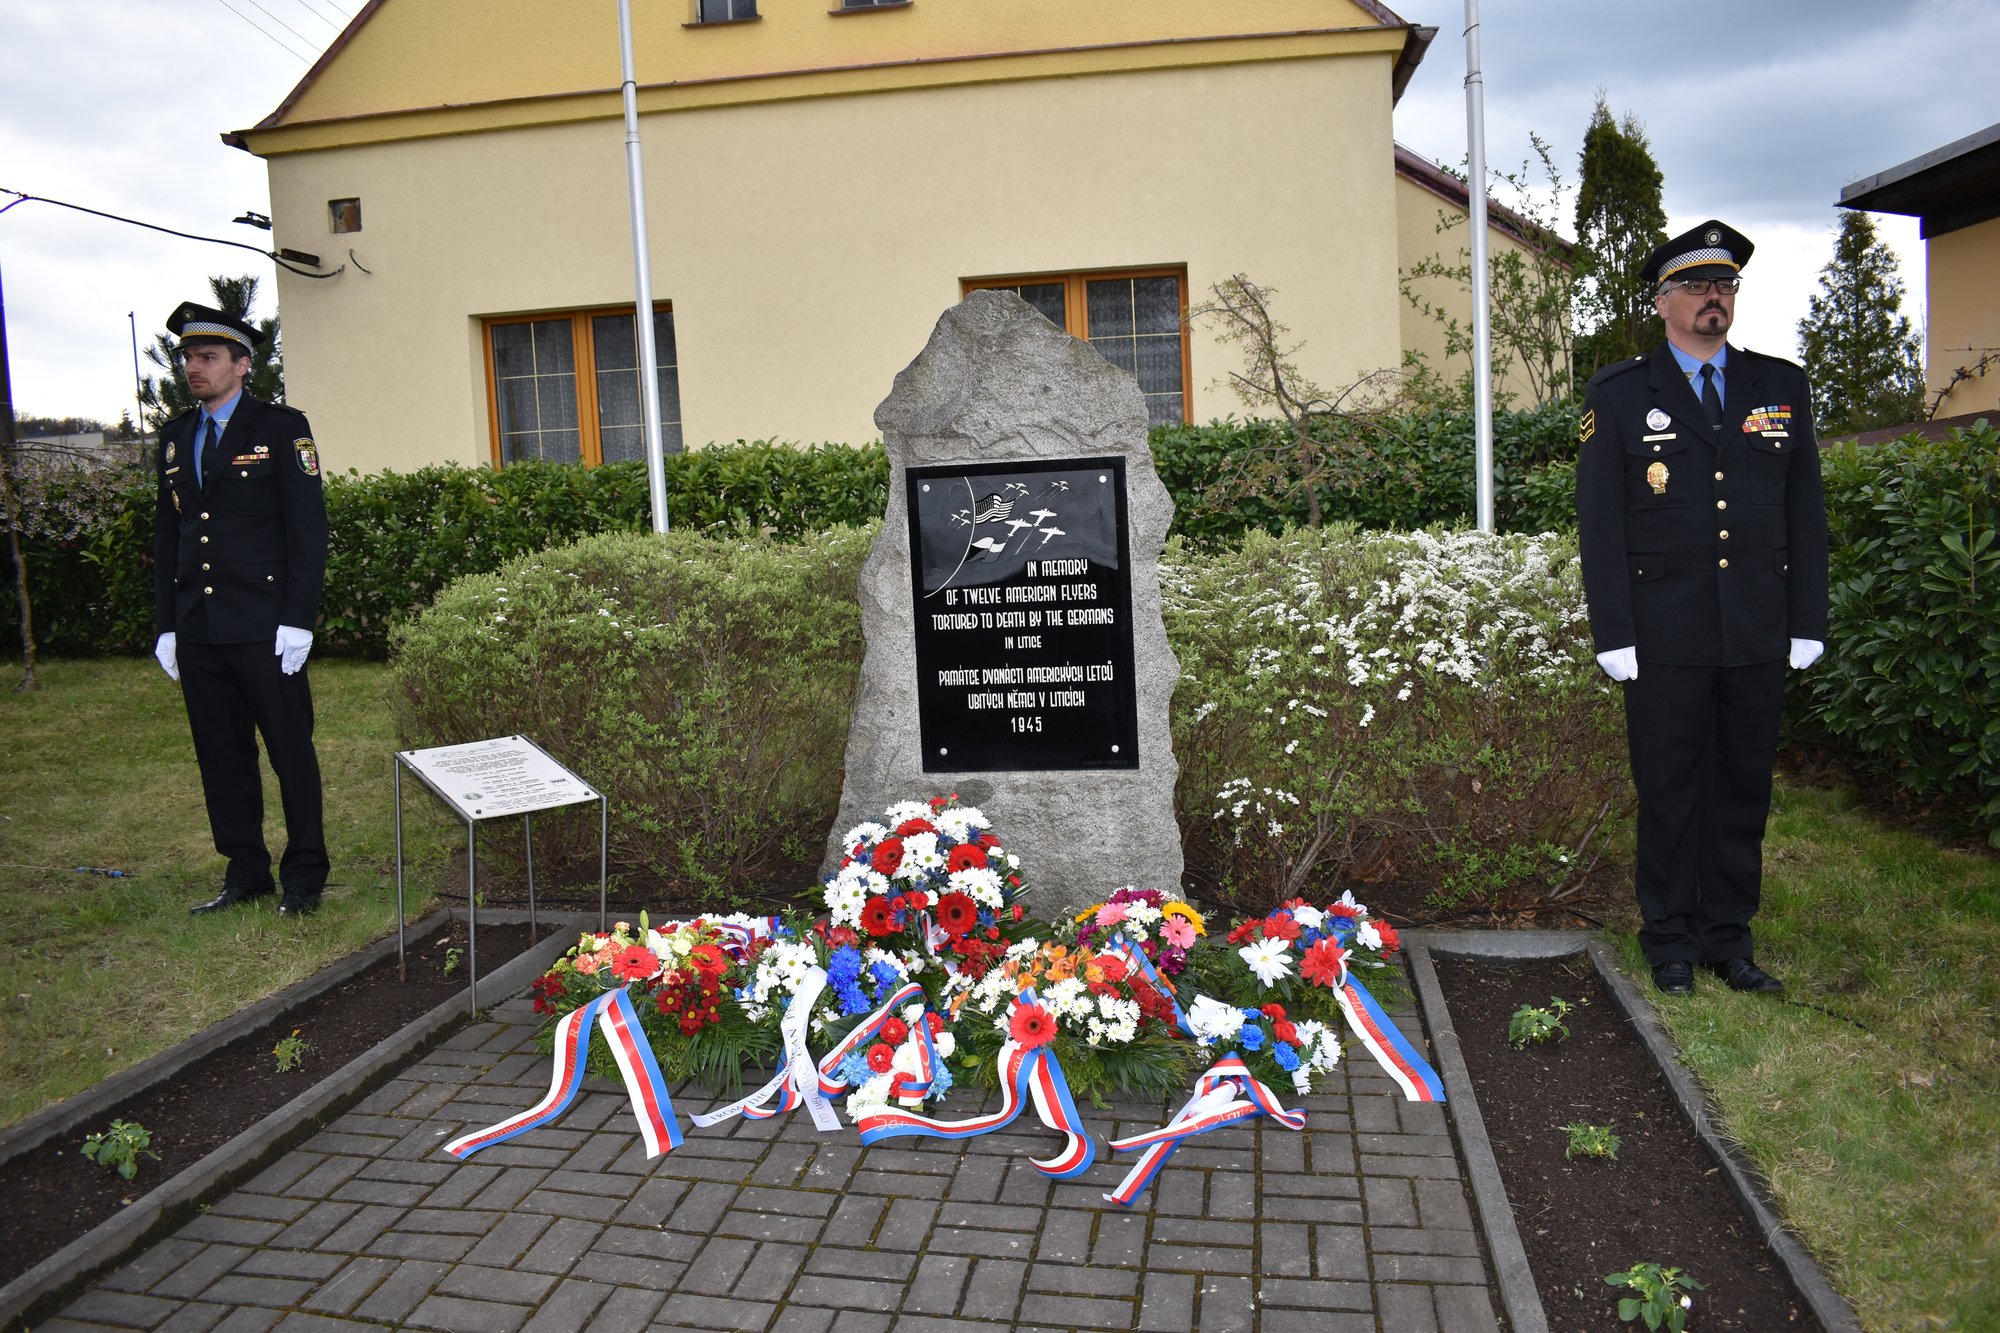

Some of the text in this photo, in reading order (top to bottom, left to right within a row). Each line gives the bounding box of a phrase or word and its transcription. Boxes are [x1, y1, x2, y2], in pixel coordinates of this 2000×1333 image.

[1026, 558, 1088, 578] IN MEMORY
[945, 583, 1098, 605] OF TWELVE AMERICAN FLYERS
[931, 607, 1114, 631] TORTURED TO DEATH BY THE GERMANS
[1004, 635, 1042, 650] IN LITICE
[938, 659, 1114, 686] PAMÁTCE DVANÁCTI AMERICKÝCH LETCŮ
[967, 685, 1086, 710] UBITÝCH NĚMCI V LITICÍCH
[1010, 716, 1042, 733] 1945
[710, 1104, 744, 1121] FROM
[747, 1090, 770, 1105] THE
[773, 1028, 798, 1089] AMERICAN
